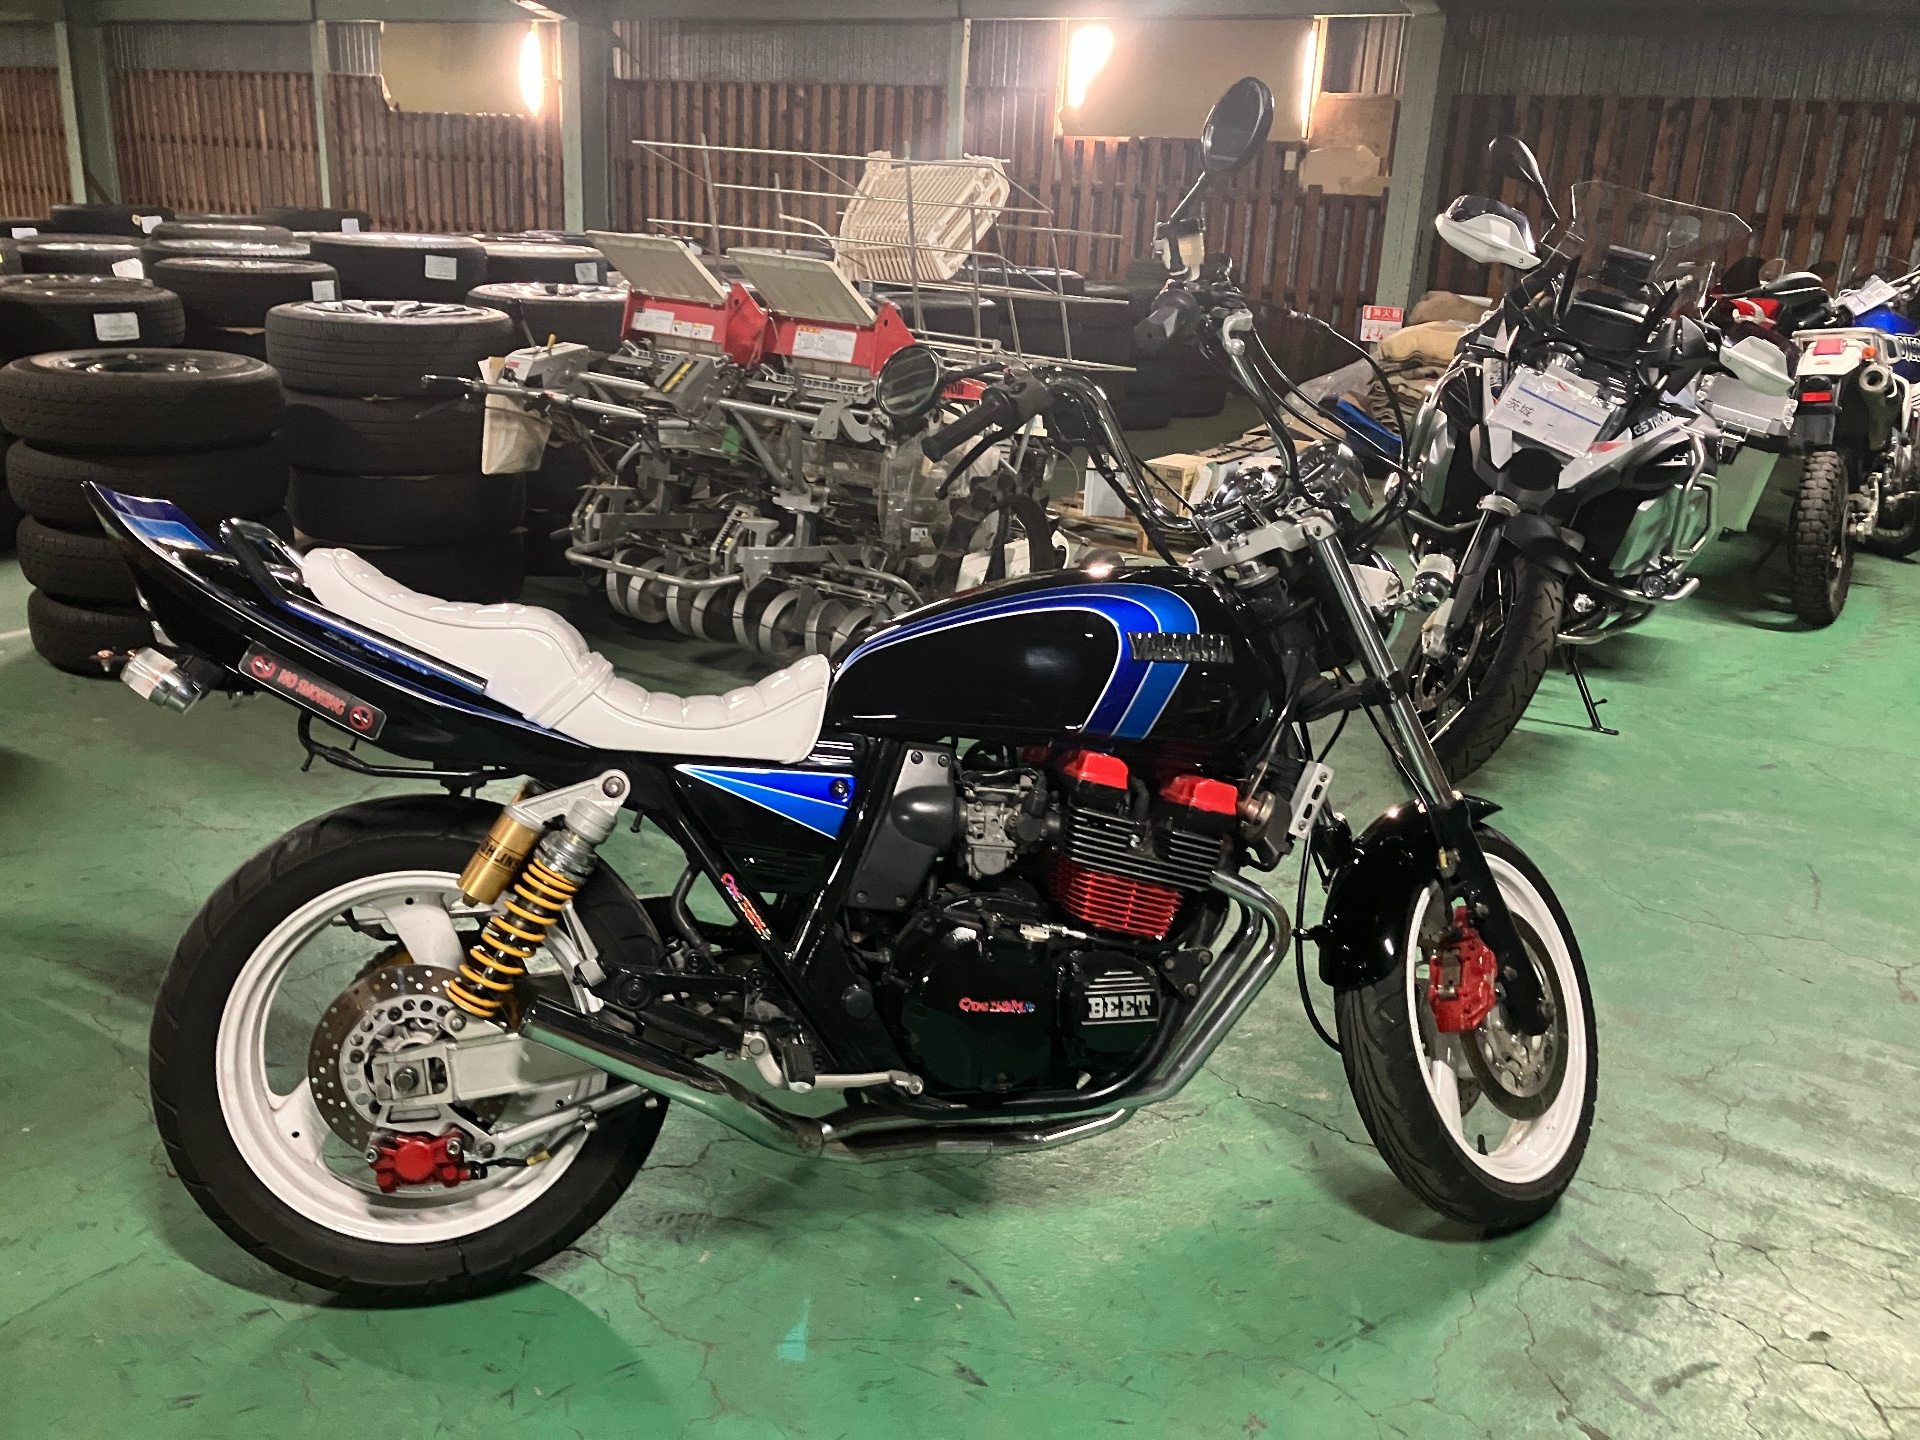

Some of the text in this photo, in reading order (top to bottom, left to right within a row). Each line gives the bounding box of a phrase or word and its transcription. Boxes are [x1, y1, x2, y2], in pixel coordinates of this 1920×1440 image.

[1126, 632, 1234, 663] YAMAHA
[277, 668, 347, 716] NO SMOKING
[1088, 994, 1150, 1019] BEET
